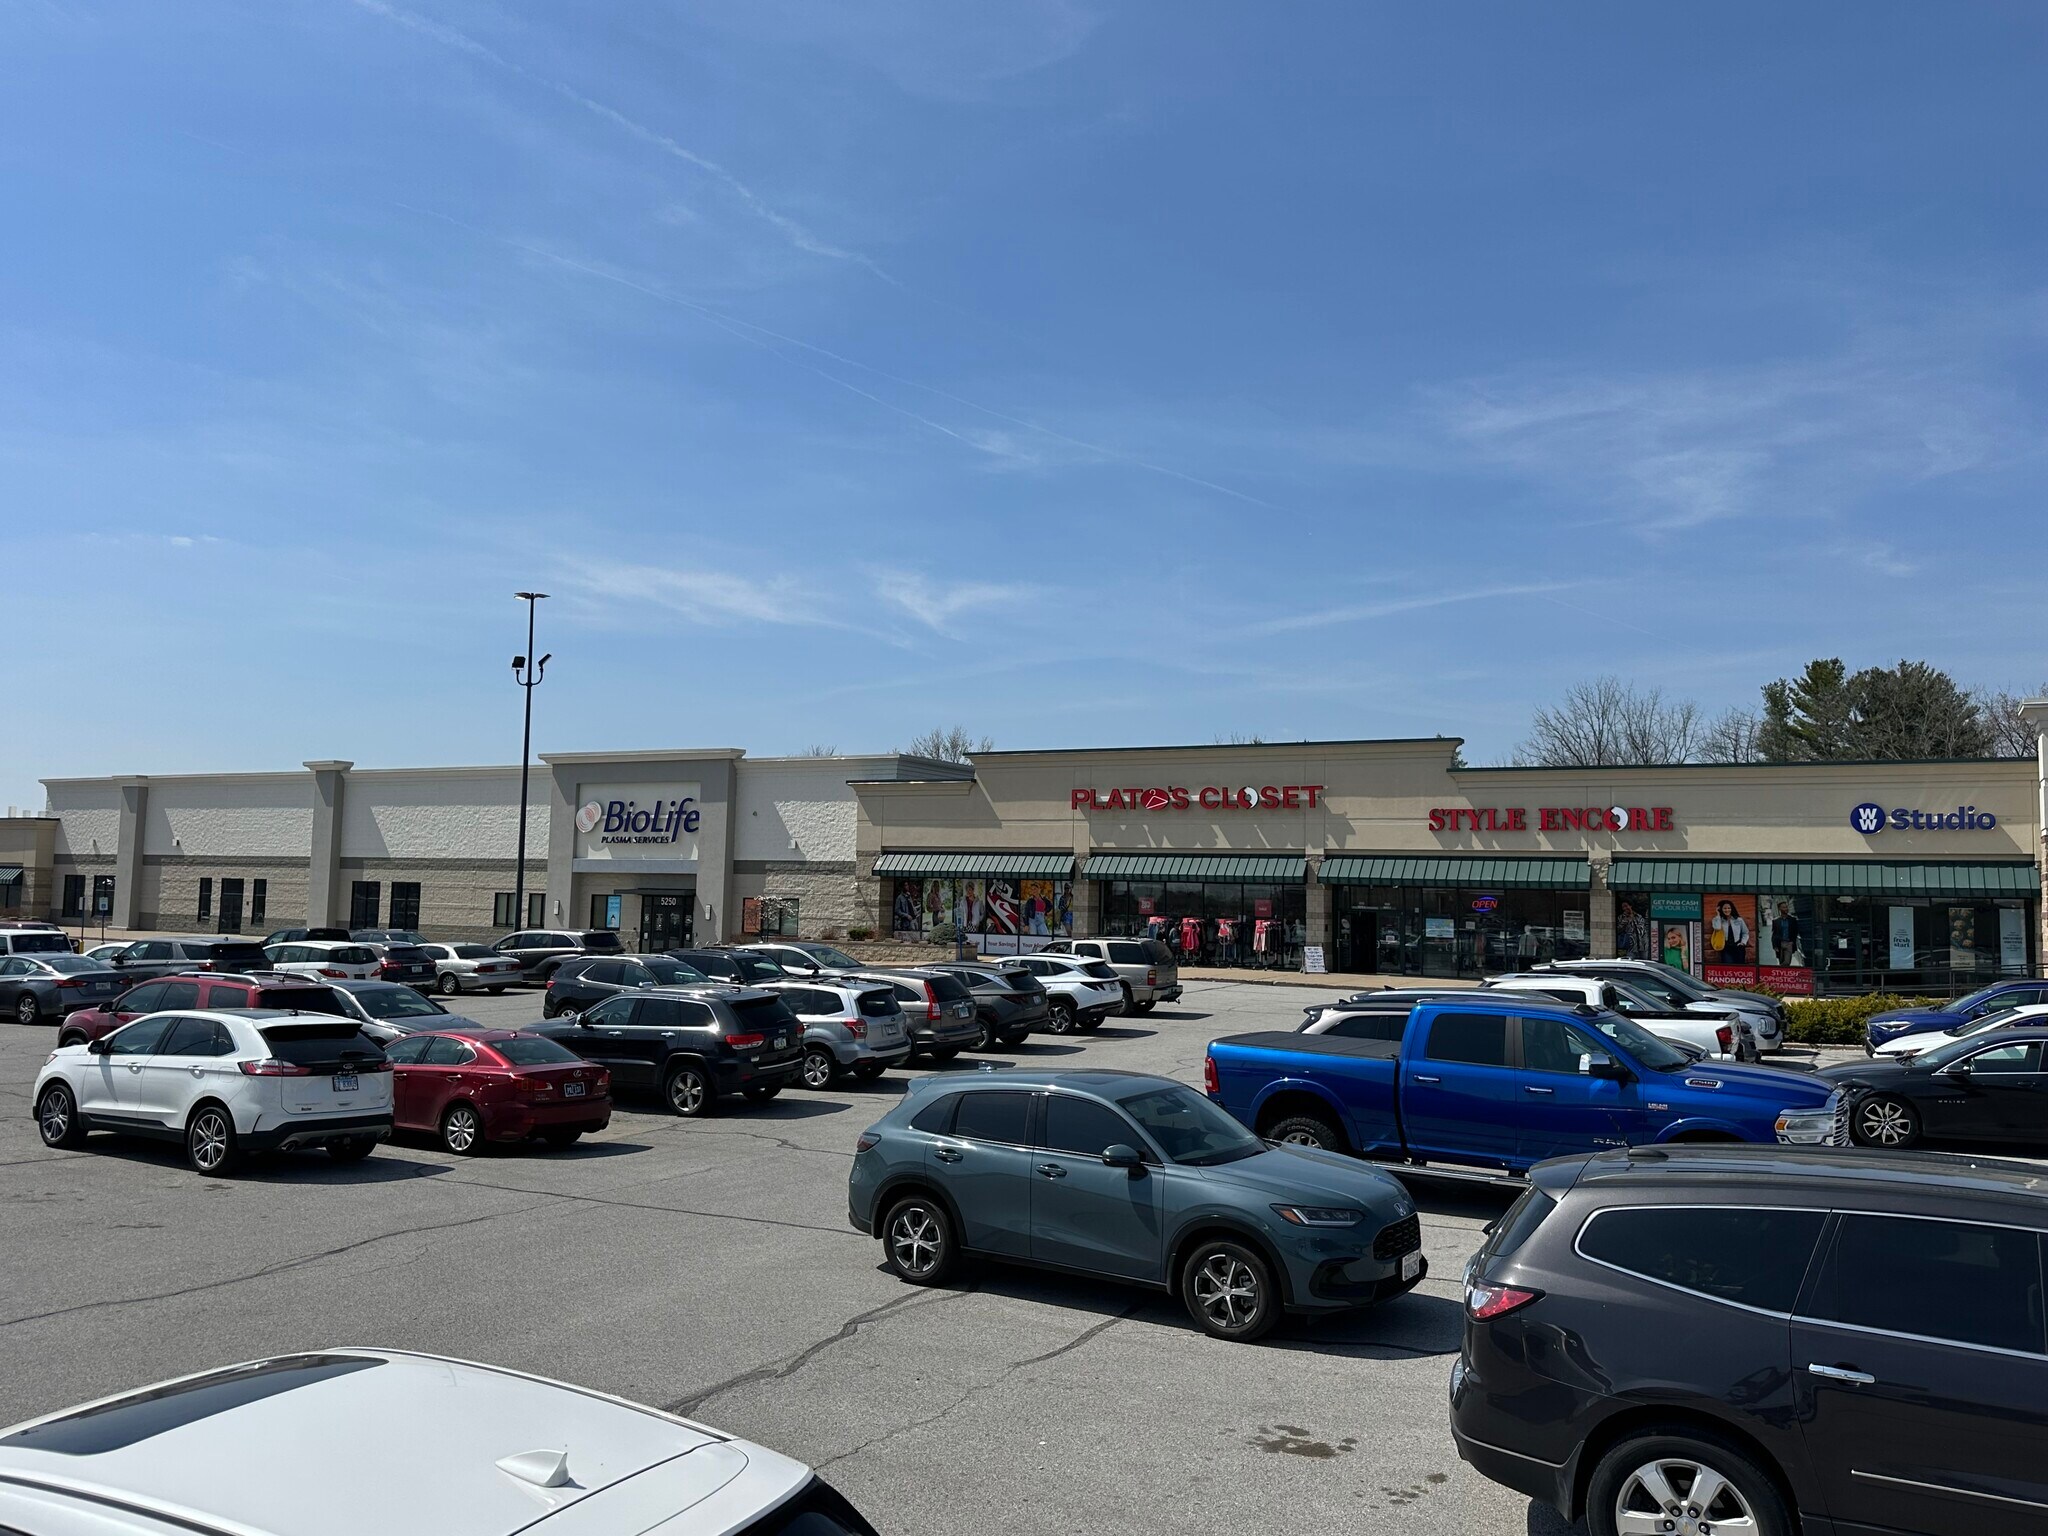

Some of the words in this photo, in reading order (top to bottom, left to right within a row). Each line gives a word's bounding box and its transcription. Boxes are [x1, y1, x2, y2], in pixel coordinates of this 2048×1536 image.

[1071, 785, 1190, 810] PLATO'S
[1199, 785, 1324, 810] CLOSET
[603, 797, 700, 843] BioLife
[1428, 807, 1527, 832] STYLE
[1538, 805, 1674, 832] ENCORE
[1890, 805, 1997, 831] Studio
[601, 836, 632, 844] PLASMA
[633, 836, 669, 844] SERVICES
[660, 897, 677, 906] 5250
[1471, 900, 1498, 909] OPEN
[1707, 976, 1754, 985] HANDBAGS!
[1759, 975, 1814, 983] SOPHISTIC
[1286, 1125, 1315, 1134] COOPER
[1593, 1137, 1628, 1146] RAM
